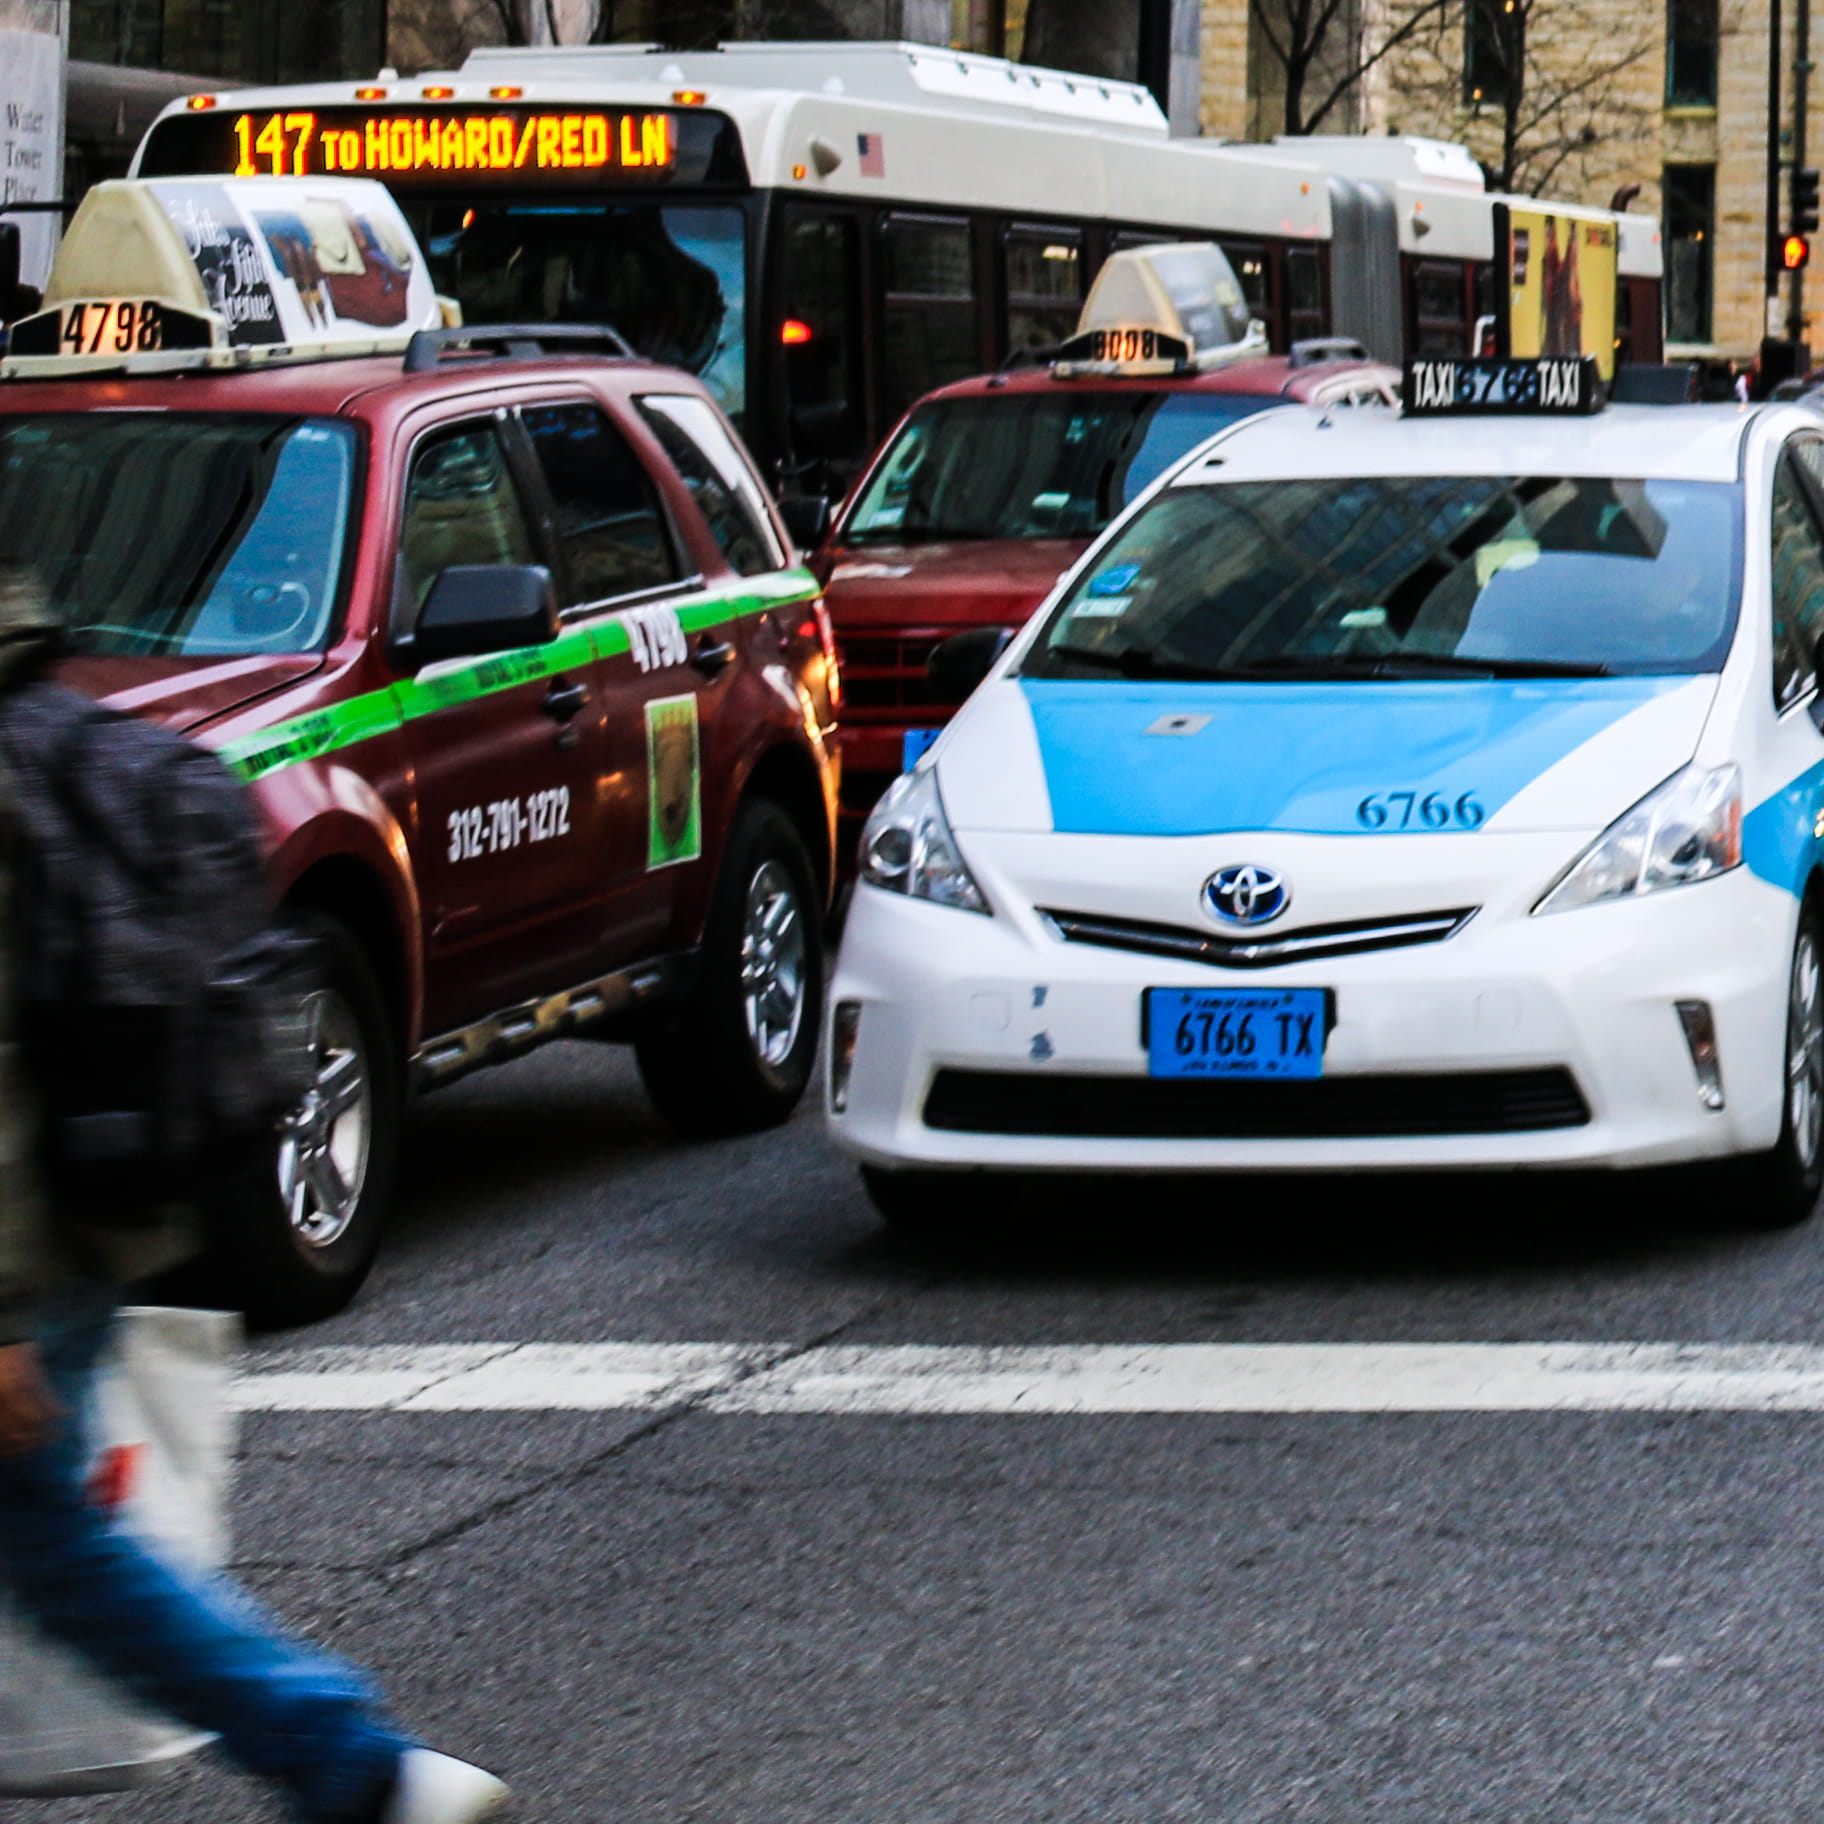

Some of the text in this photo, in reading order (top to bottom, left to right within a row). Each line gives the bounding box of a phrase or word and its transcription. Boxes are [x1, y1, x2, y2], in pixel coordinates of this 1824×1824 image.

[234, 113, 314, 177] 147
[365, 115, 607, 170] HOWARD/RED
[619, 115, 668, 167] LN
[64, 301, 163, 354] 4798
[1413, 361, 1455, 407] TAXI
[1537, 361, 1580, 407] TAXI
[1356, 790, 1485, 829] 6766
[1175, 1012, 1314, 1056] 6766 TX
